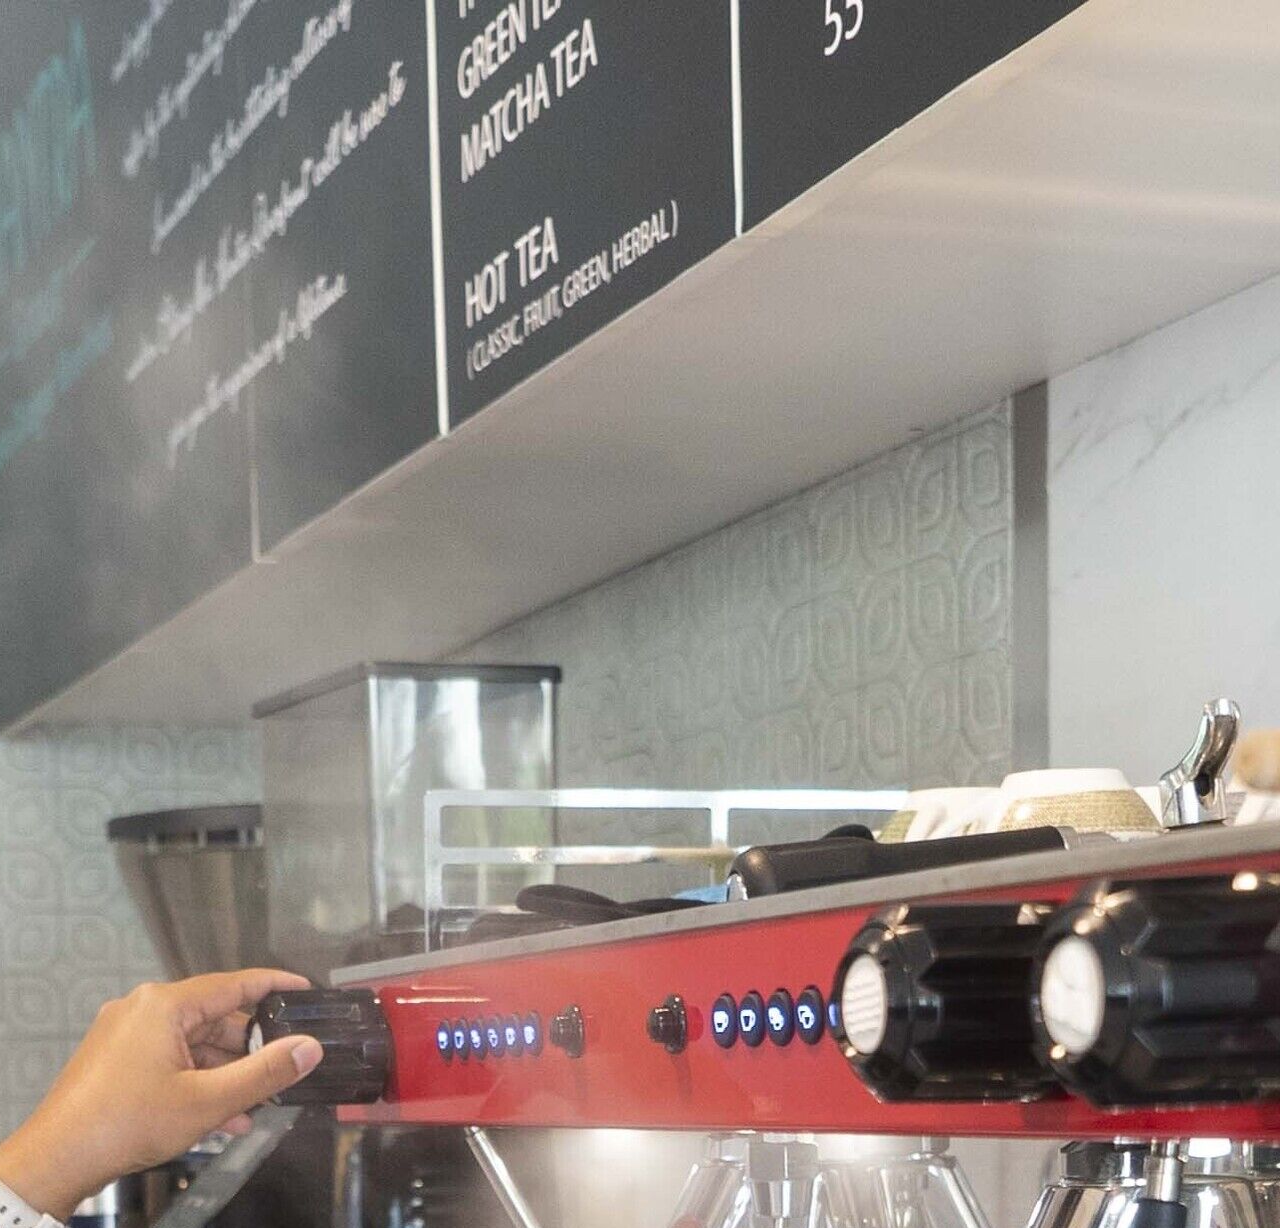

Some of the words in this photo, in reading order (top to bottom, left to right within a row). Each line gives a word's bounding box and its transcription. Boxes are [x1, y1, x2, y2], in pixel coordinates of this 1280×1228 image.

[458, 4, 526, 98] GREEN
[824, 0, 864, 56] 55
[461, 62, 551, 183] MATCHA
[550, 18, 598, 97] TEA
[465, 251, 509, 328] HOT
[514, 216, 559, 287] TEA
[562, 250, 611, 308] GREEN,
